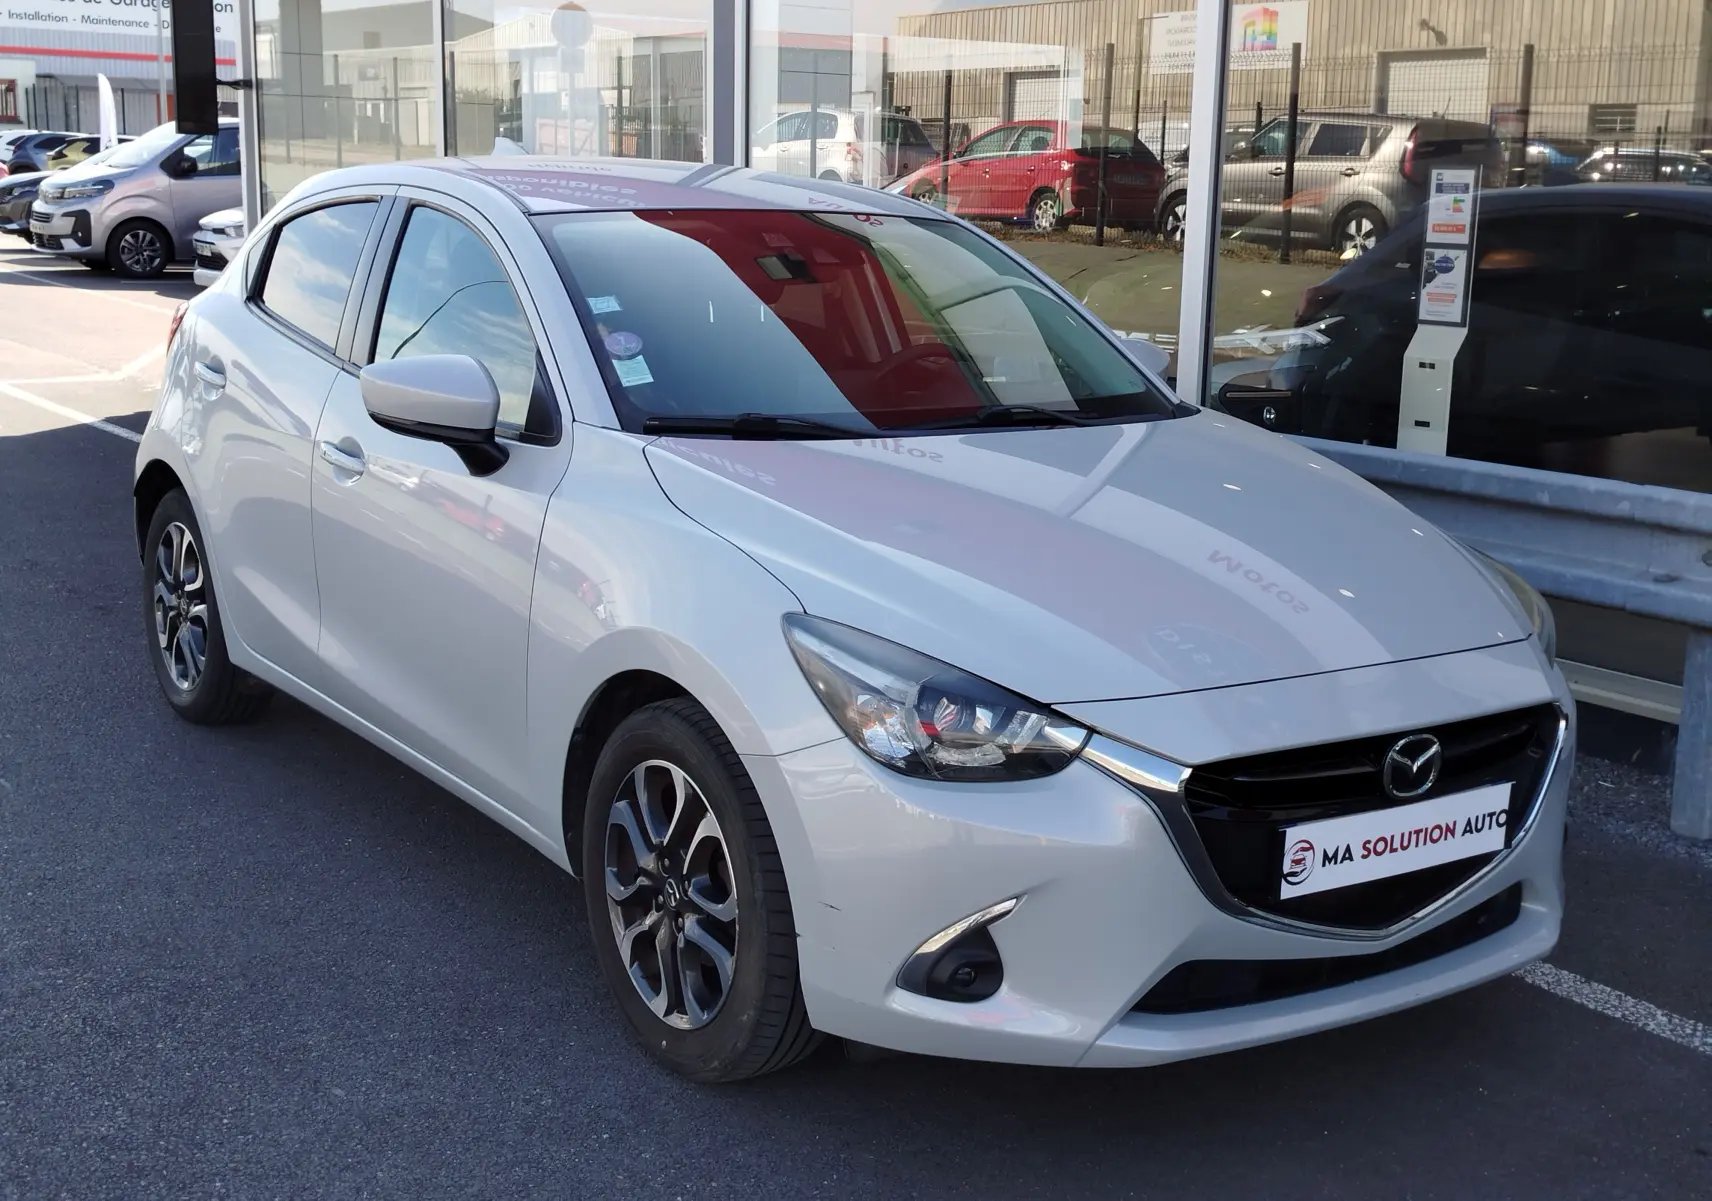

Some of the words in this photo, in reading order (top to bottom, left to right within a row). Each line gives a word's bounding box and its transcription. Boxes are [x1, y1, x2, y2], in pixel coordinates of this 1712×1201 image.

[8, 9, 68, 23] Installation
[81, 15, 149, 28] Maintenance
[1321, 843, 1354, 868] MA
[1361, 820, 1457, 860] SOLUTION
[1461, 808, 1509, 837] AUTO
